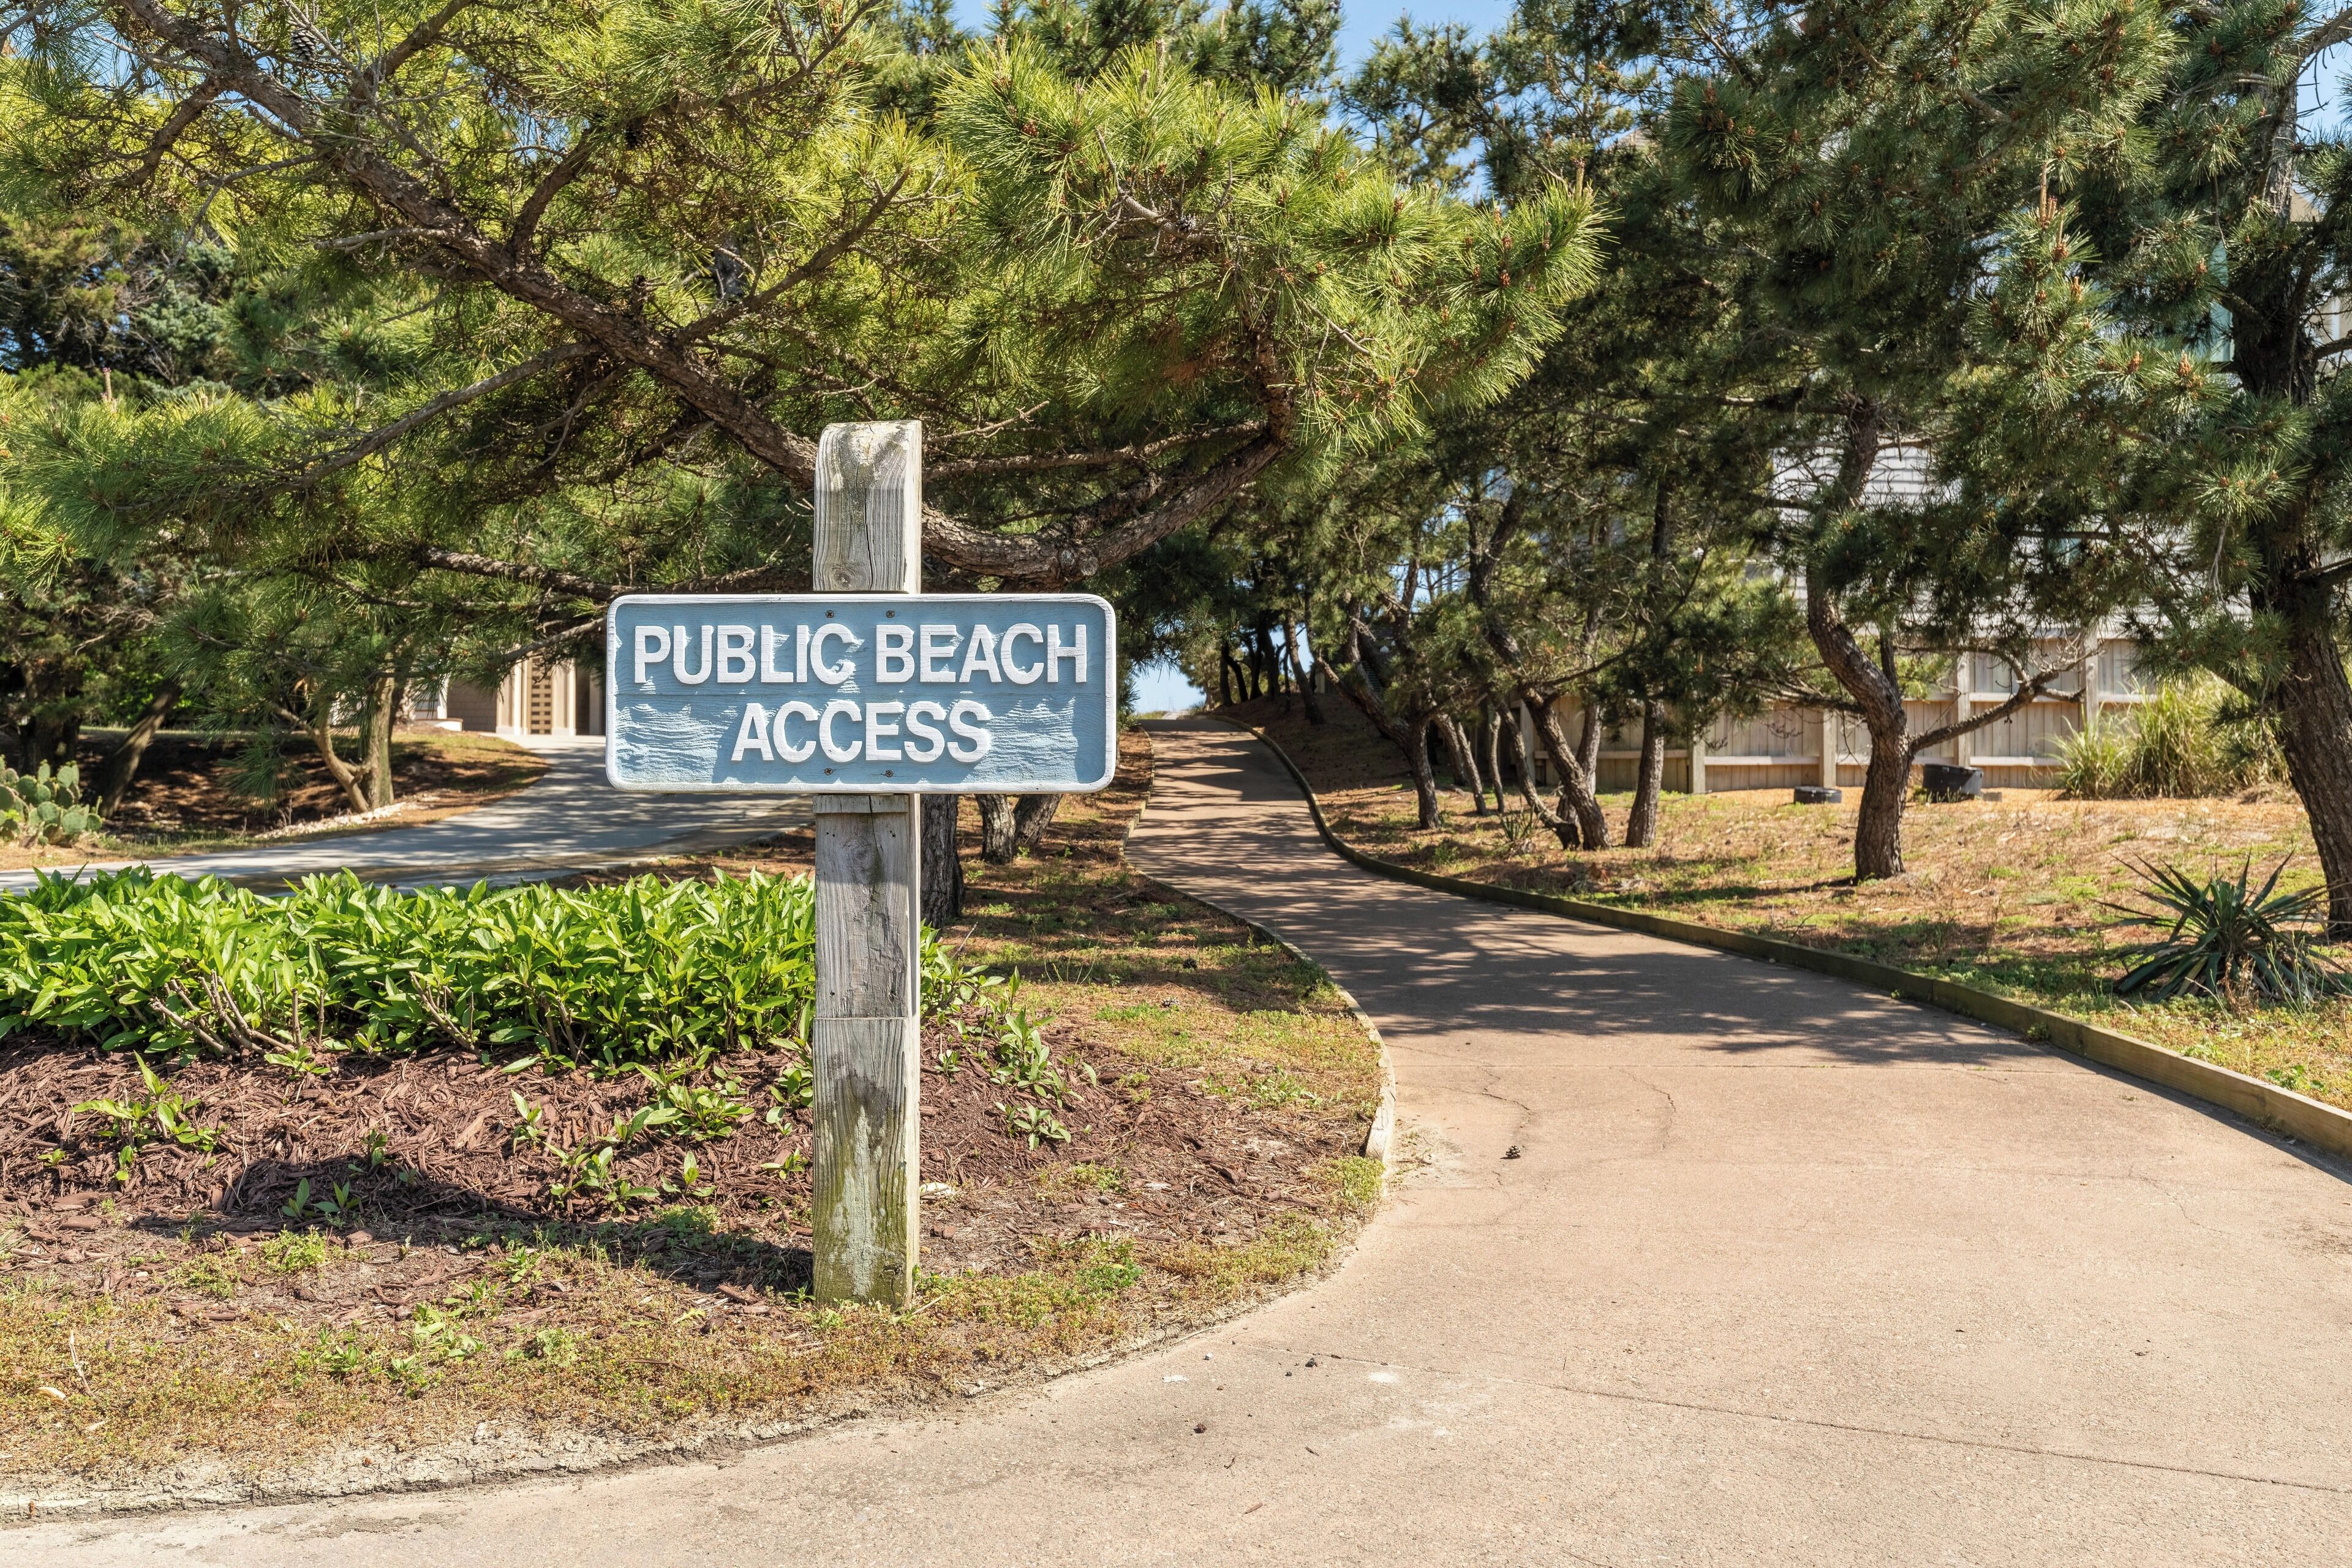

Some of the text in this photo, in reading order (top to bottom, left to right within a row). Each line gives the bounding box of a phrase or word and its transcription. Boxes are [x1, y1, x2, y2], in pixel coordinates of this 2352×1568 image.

[634, 623, 1087, 685] PUBLIC BEACH
[731, 700, 991, 763] ACCESS
